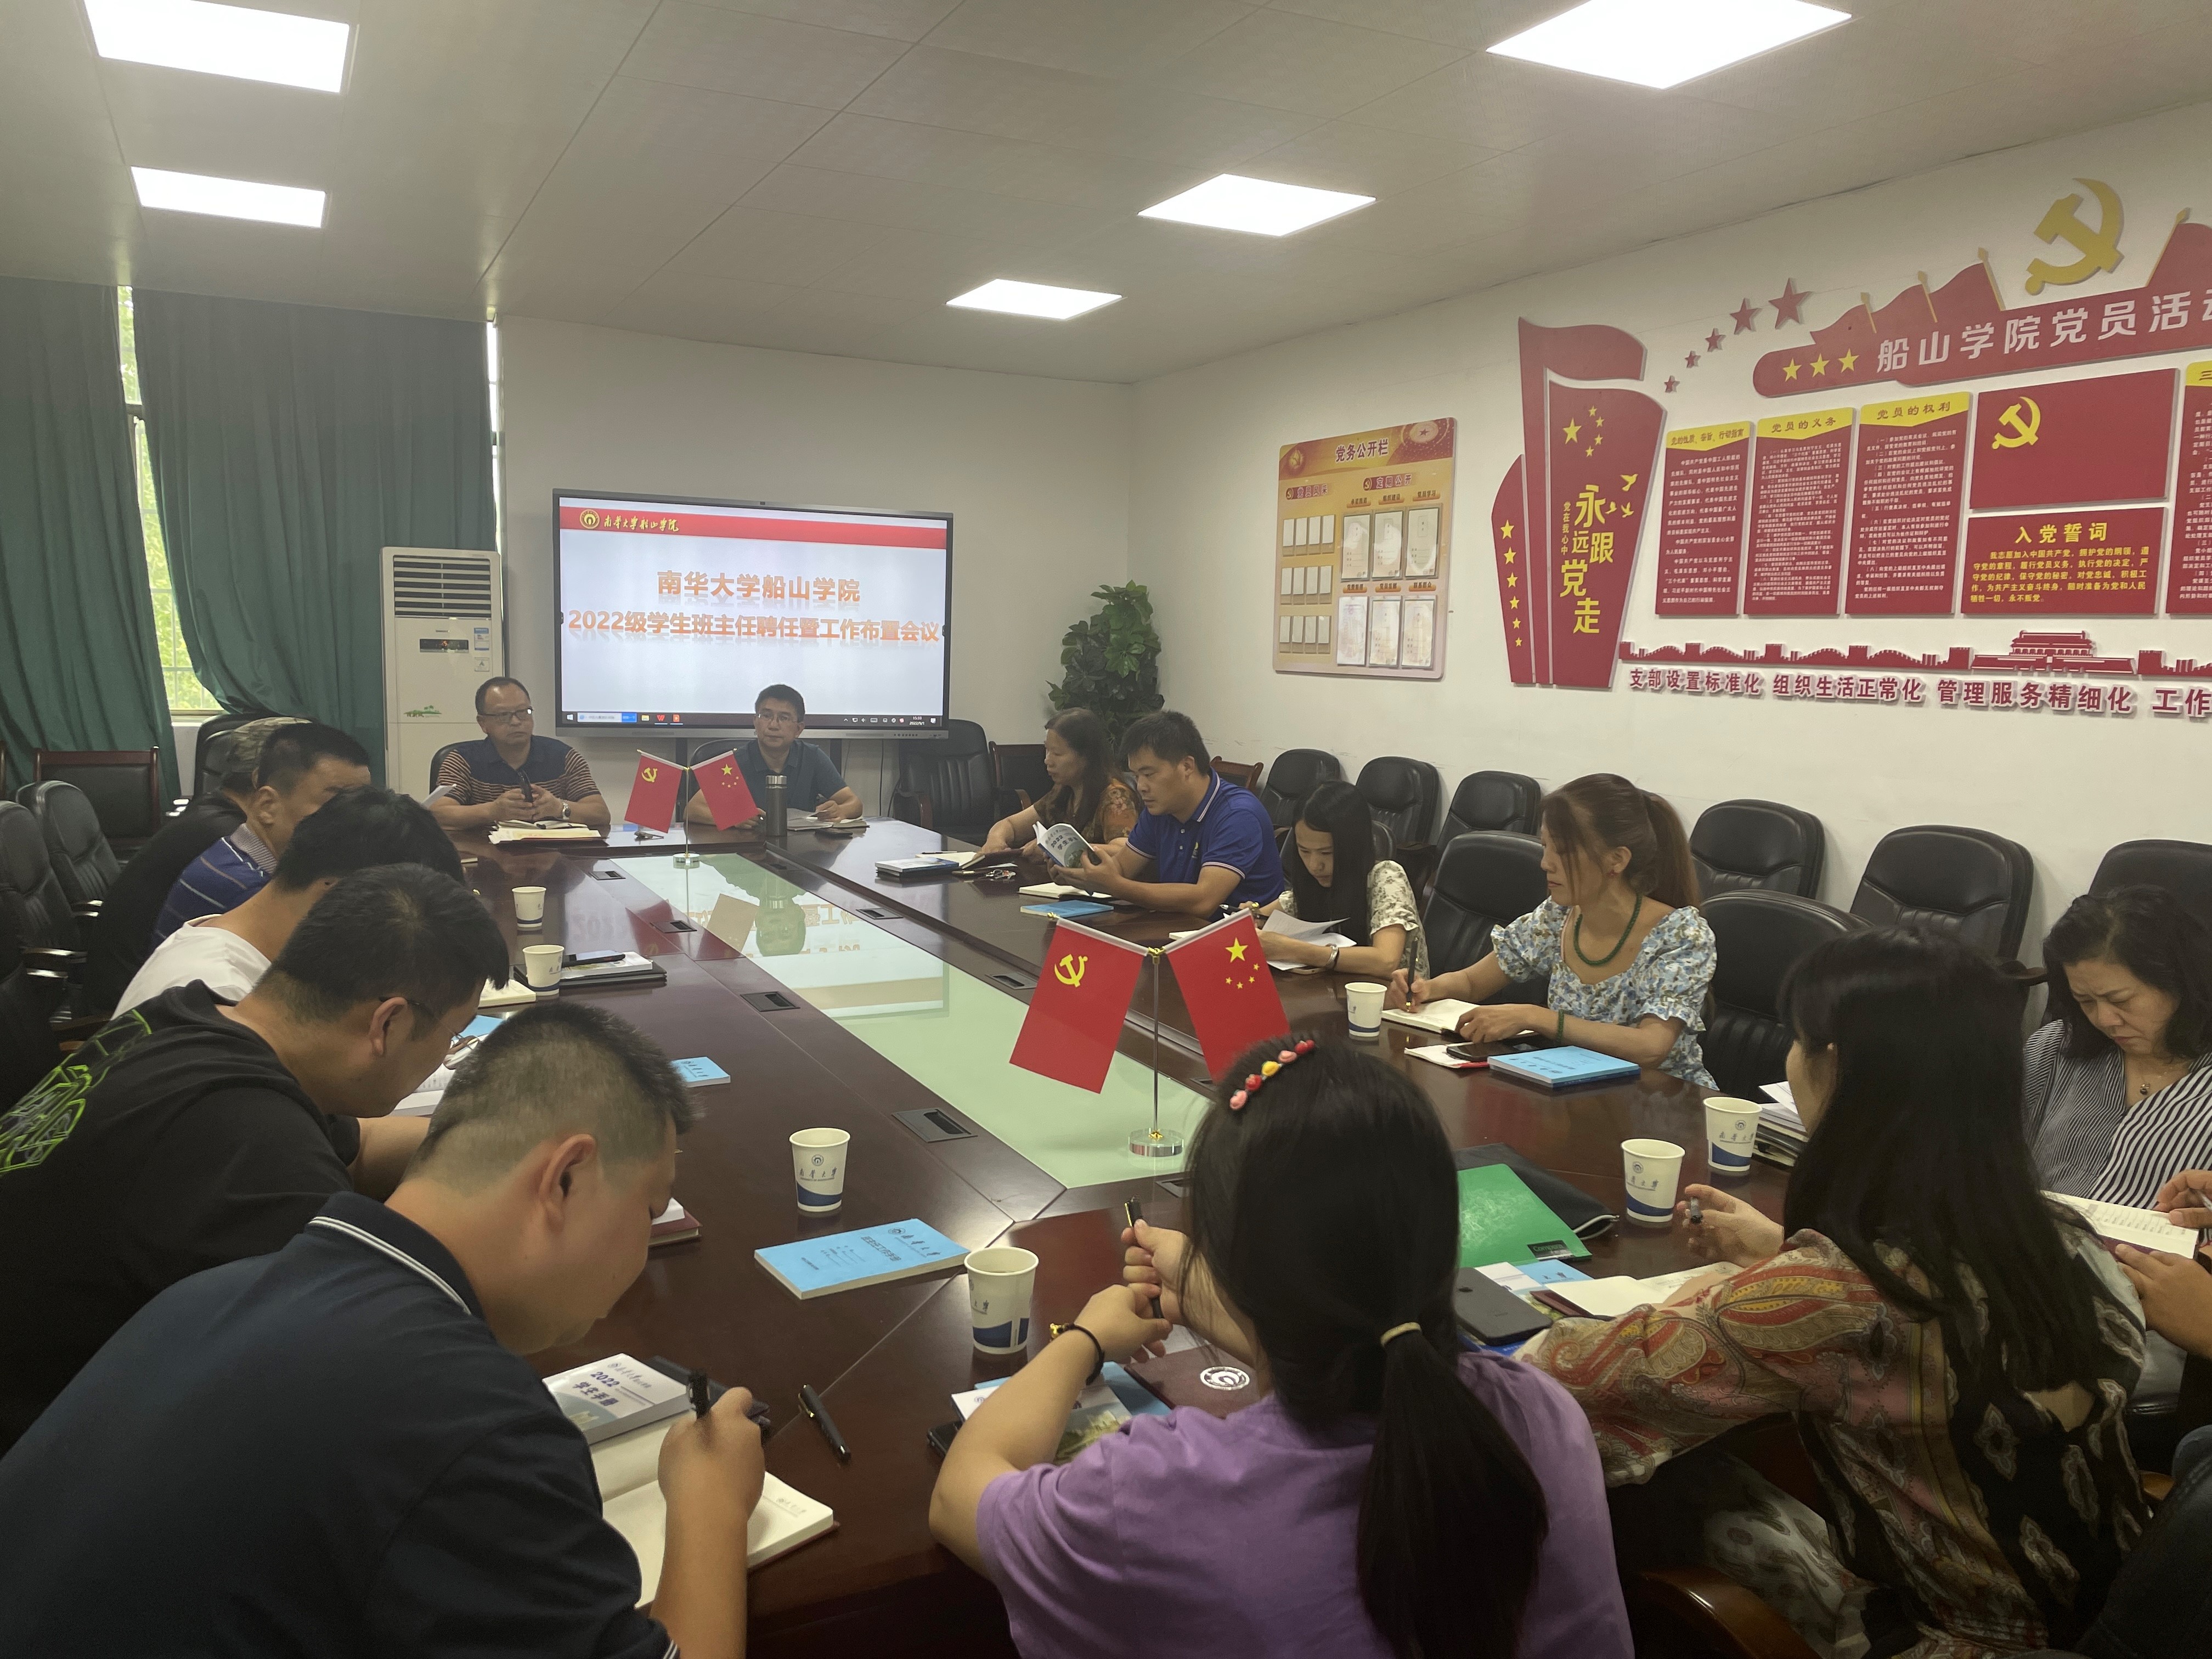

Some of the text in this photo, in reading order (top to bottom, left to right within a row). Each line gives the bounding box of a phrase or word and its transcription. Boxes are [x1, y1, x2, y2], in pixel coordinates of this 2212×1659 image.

[1876, 289, 2212, 373] 船山学院党员活
[1877, 401, 1951, 420] 党员的权利
[1771, 417, 1837, 433] 党员的义务
[1336, 438, 1389, 462] 党务公开栏
[1560, 501, 1571, 556] 党在我心中
[2015, 522, 2107, 544] 入党誓词
[657, 570, 861, 602] 南华大学船山学院
[568, 610, 939, 642] 2022级学生班主任聘任暨工作布置会议
[1629, 668, 2212, 715] 支部设置标准化 组织生活正常化 管理服务精细化 工作
[590, 1372, 620, 1387] 2022
[573, 1381, 619, 1406] 学生手册
